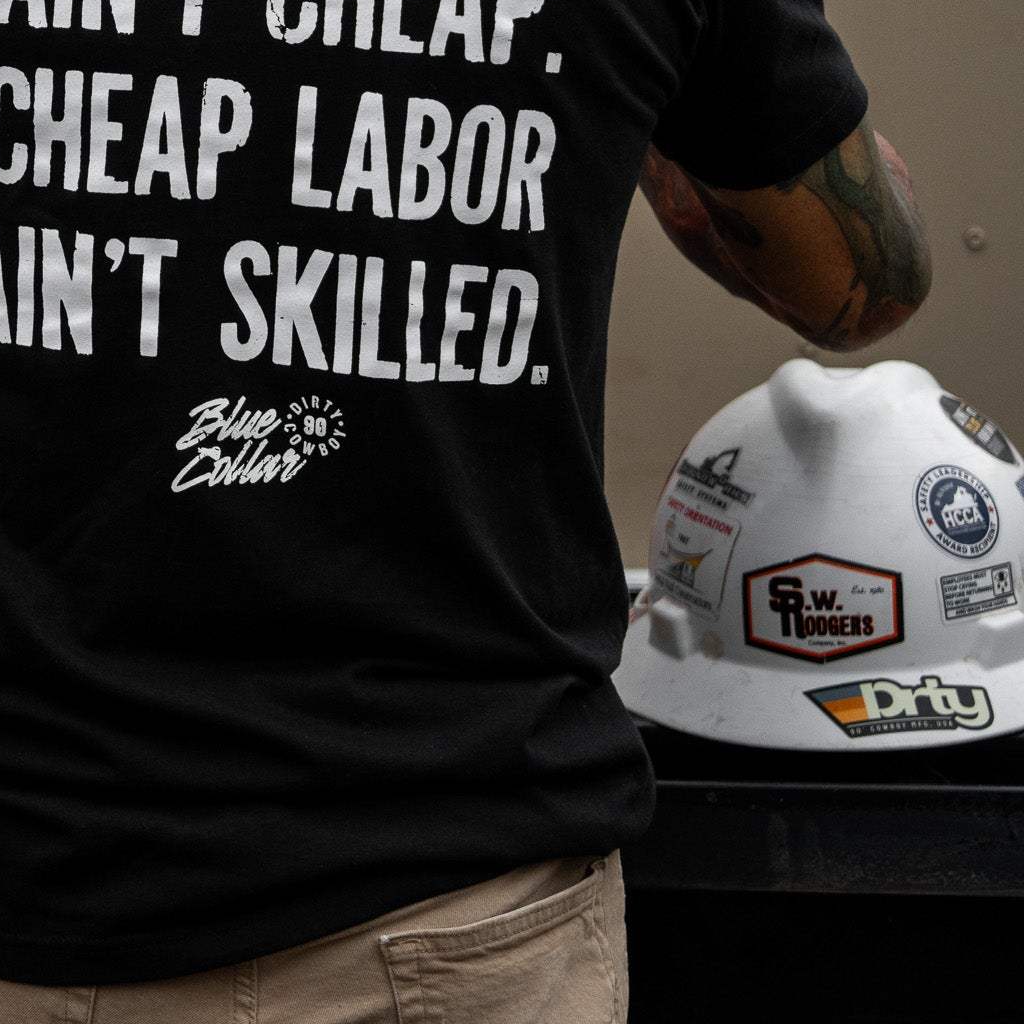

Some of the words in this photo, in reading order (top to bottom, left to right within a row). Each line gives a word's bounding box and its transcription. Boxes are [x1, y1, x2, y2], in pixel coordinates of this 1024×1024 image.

[292, 86, 556, 231] LABOR
[221, 240, 548, 385] SKILLED.
[176, 396, 282, 450] Blue
[290, 395, 343, 419] DIRTY
[284, 423, 346, 456] COWBOY
[304, 415, 326, 437] 90
[171, 439, 307, 493] Collar
[919, 476, 932, 512] SAFETY
[941, 506, 984, 529] HCCA
[936, 533, 968, 554] AWARD
[769, 576, 843, 612] S.W.
[780, 590, 874, 639] RODGERS
[859, 677, 989, 727] Drty
